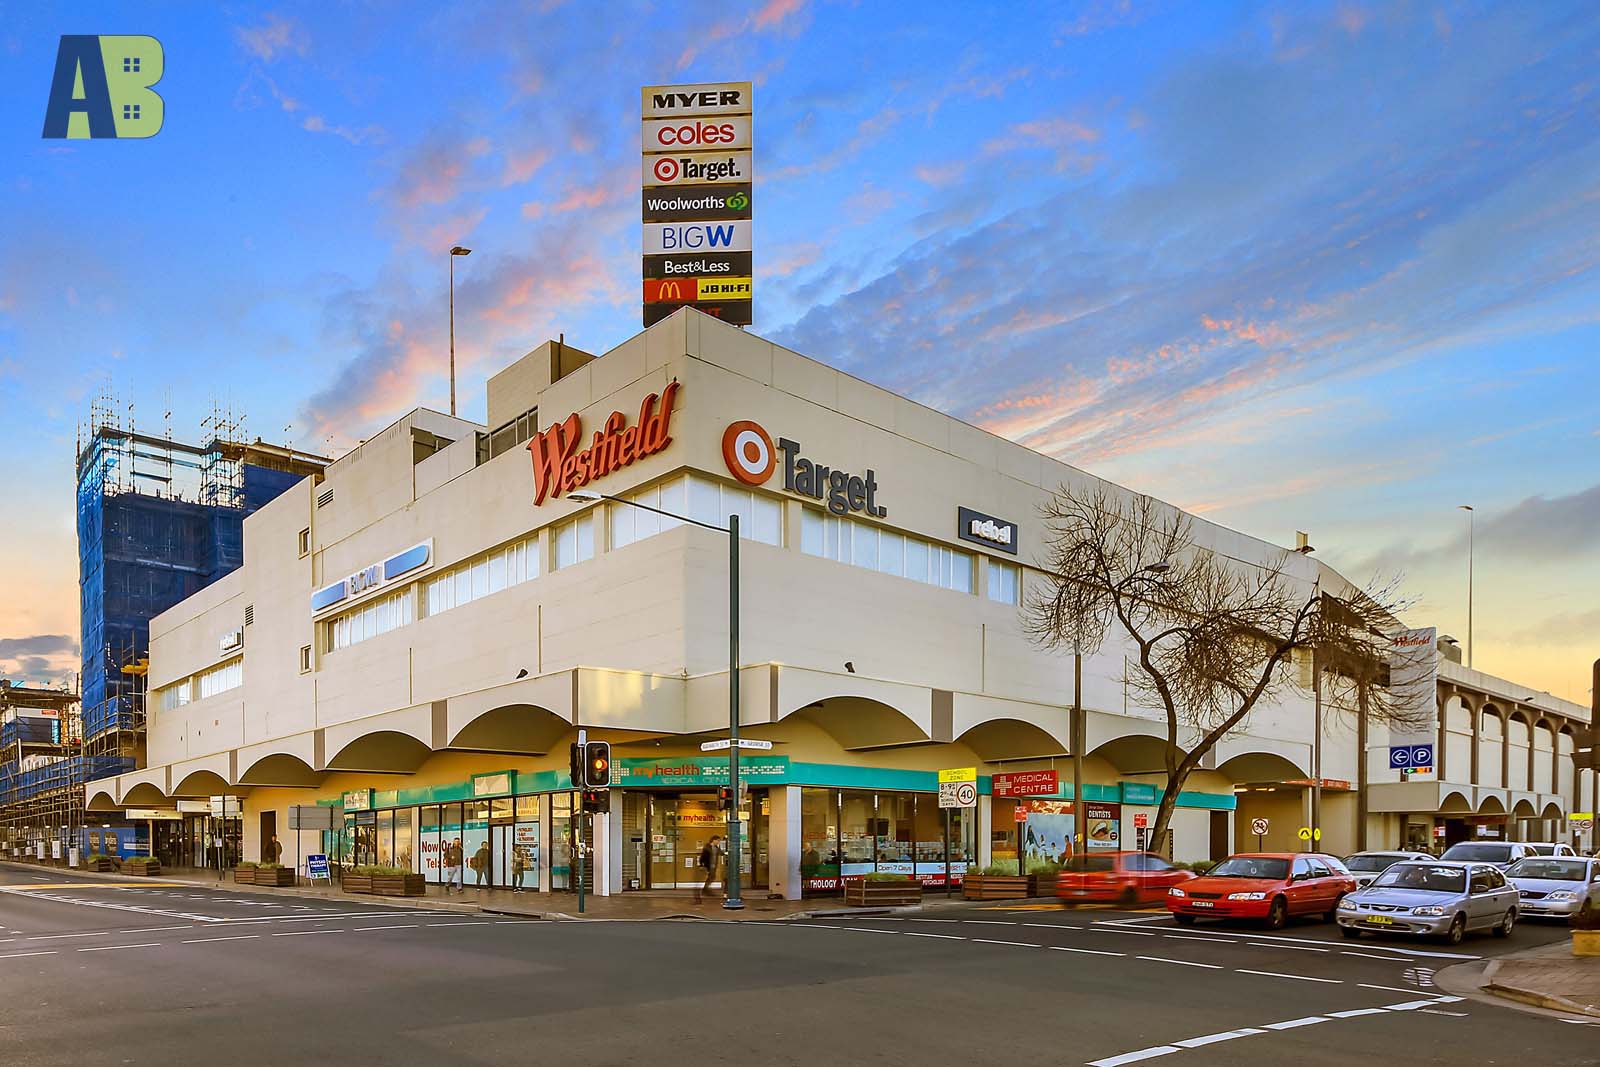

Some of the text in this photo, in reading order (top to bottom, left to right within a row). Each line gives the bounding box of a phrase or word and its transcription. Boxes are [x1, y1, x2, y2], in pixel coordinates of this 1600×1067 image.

[653, 91, 740, 109] MYER
[658, 122, 735, 145] coles
[648, 196, 725, 211] Woolworths
[664, 260, 730, 274] Best&Less
[701, 285, 719, 294] JB
[526, 380, 681, 507] Westfield
[633, 764, 700, 778] myhealth
[1013, 773, 1053, 783] MEDICAL
[960, 789, 973, 799] 40
[1013, 784, 1053, 794] CENTRE
[1088, 810, 1111, 819] DENTISTS
[422, 841, 439, 853] Now
